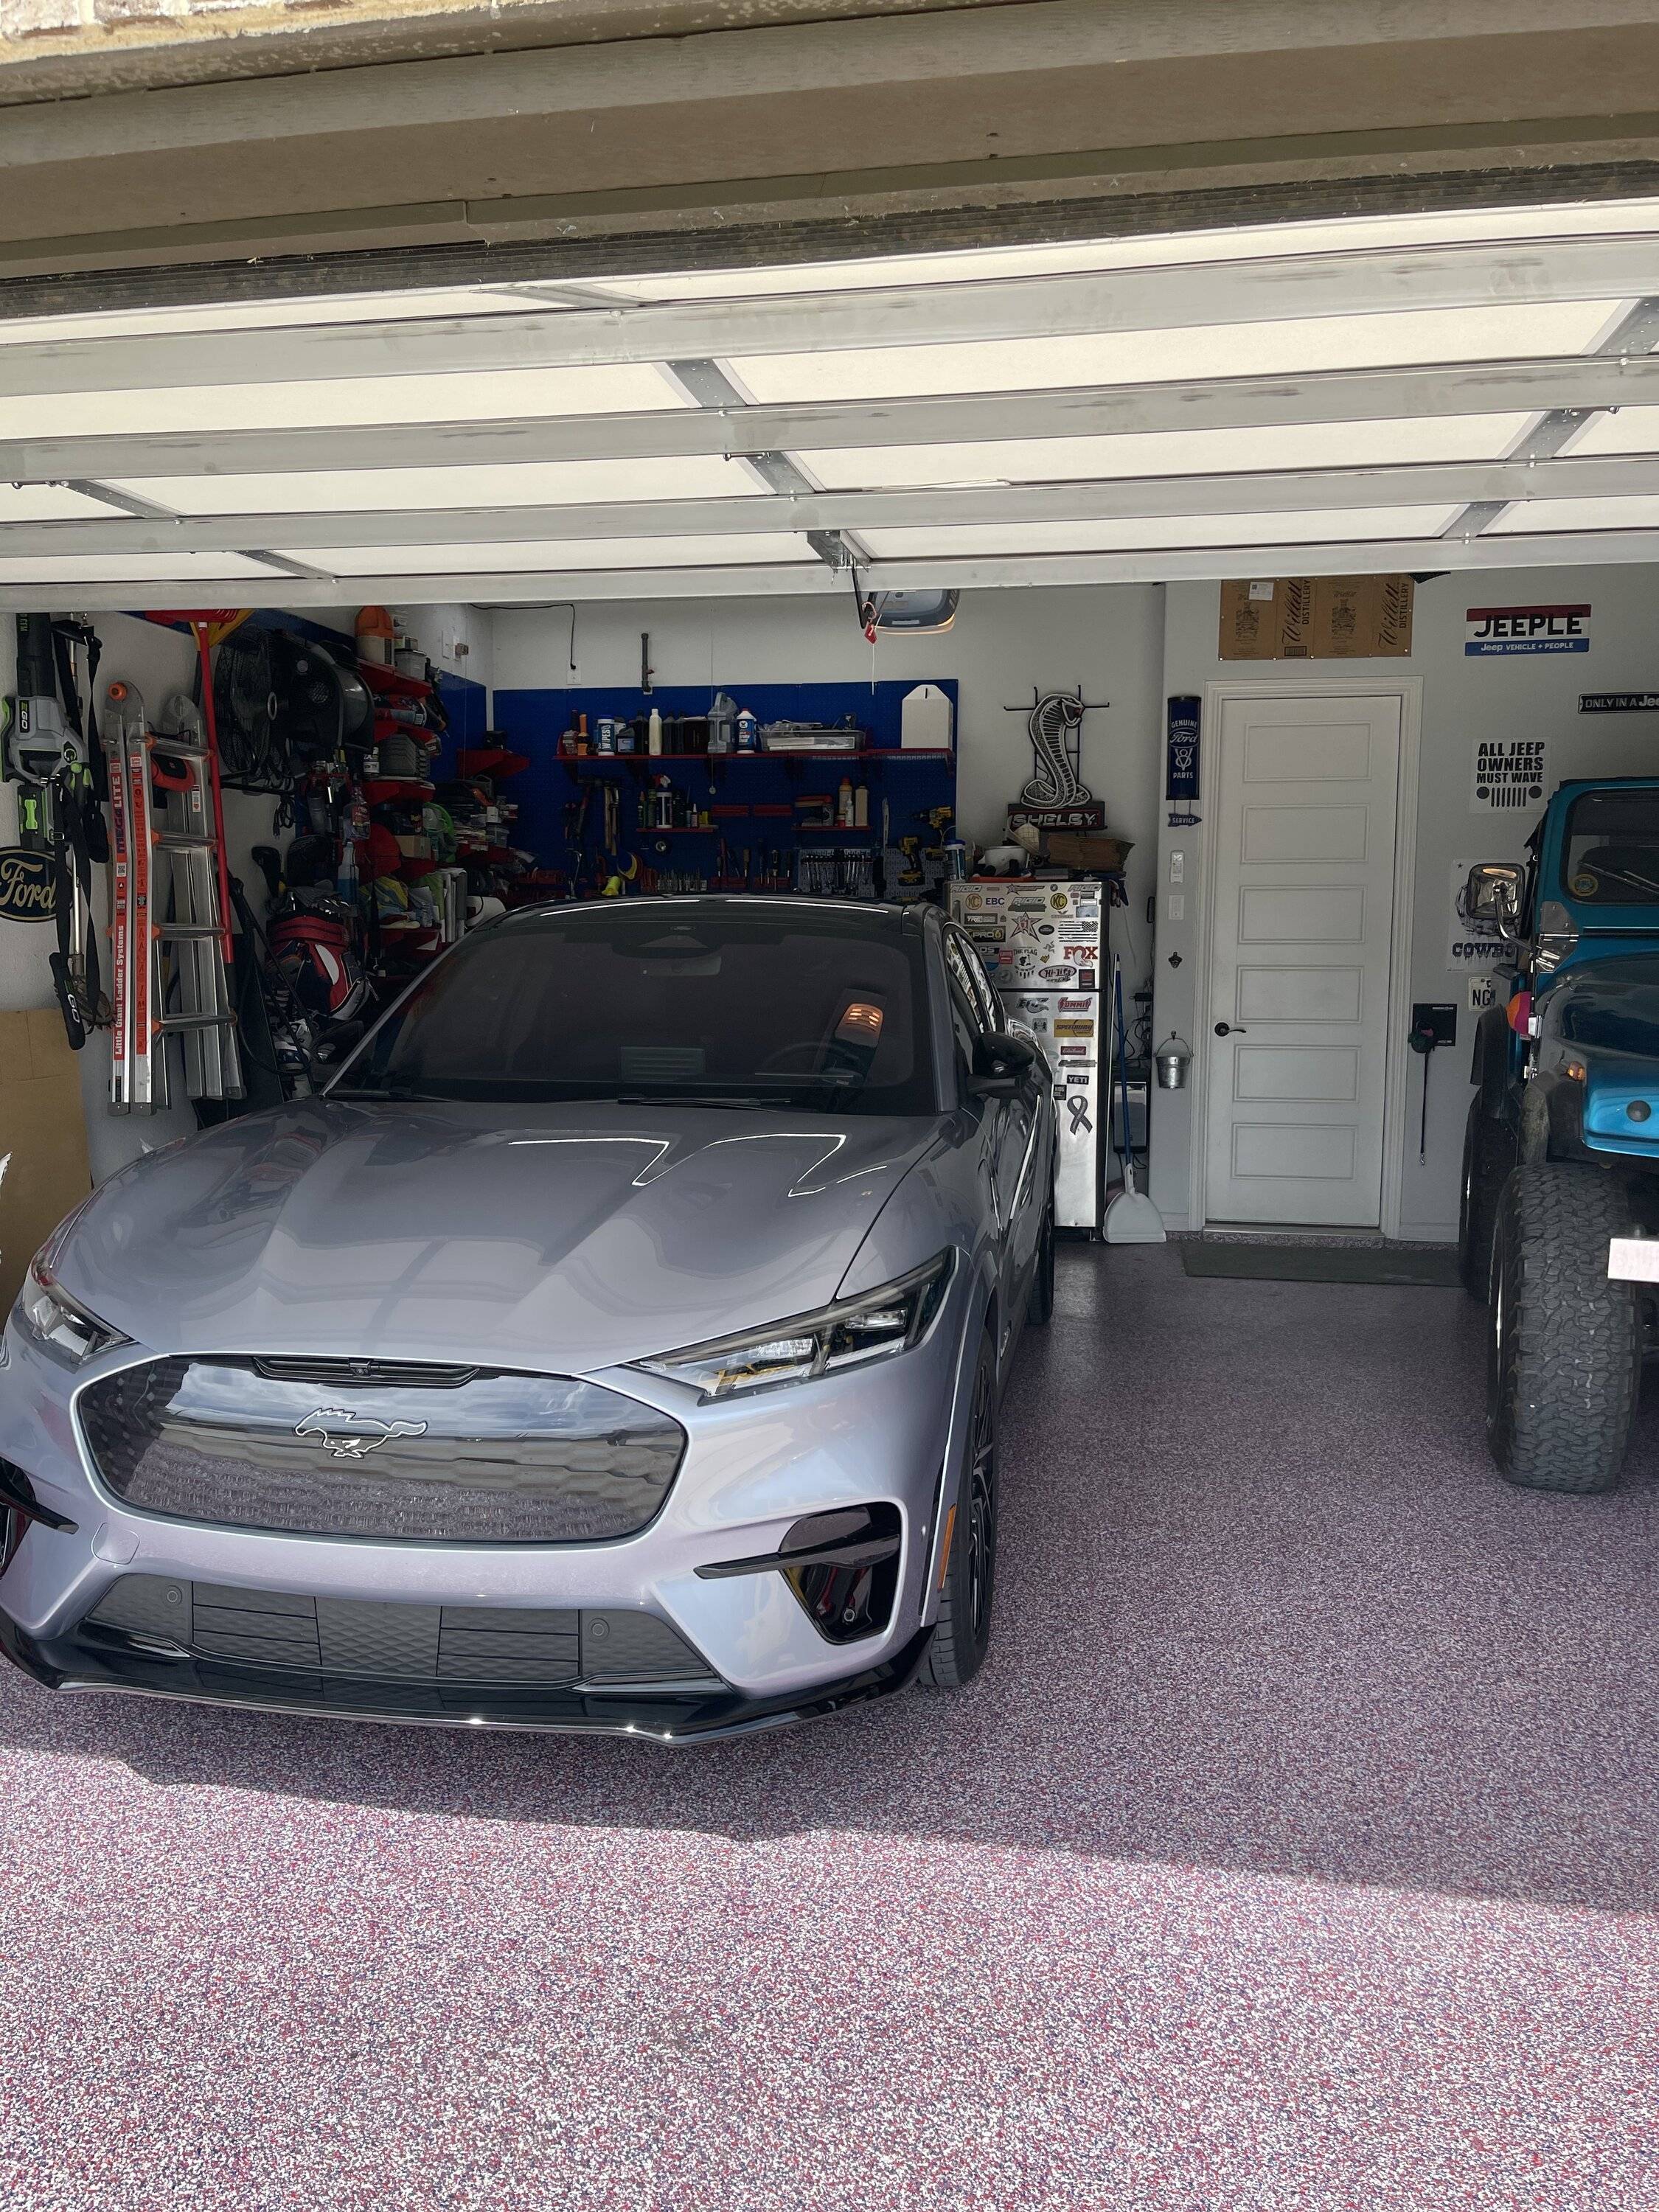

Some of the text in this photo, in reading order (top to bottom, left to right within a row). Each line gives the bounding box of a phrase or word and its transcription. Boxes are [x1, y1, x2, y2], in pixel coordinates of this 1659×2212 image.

[1301, 580, 1311, 625] DISTILLERY
[1399, 582, 1409, 628] DISTILLERY
[1473, 612, 1583, 638] JEEPLE
[1481, 643, 1503, 652] Jeep
[1585, 698, 1615, 708] ONLY
[1615, 698, 1627, 707] IN
[1630, 698, 1637, 707] A
[1169, 731, 1198, 743] Ford
[1478, 742, 1545, 757] ALL JEEP
[1477, 757, 1543, 771] OWNERS
[1476, 772, 1543, 783] MUST WAVE
[1012, 813, 1096, 826] SHELBY
[0, 858, 56, 909] Ford
[985, 897, 1005, 905] EBC
[116, 925, 124, 966] Systems
[1063, 945, 1098, 960] FOX
[115, 969, 124, 1001] Ladder
[1058, 998, 1092, 1011] SUMMIT
[115, 1004, 123, 1028] Giant
[114, 1030, 122, 1055] Little
[1068, 1076, 1088, 1084] YETI
